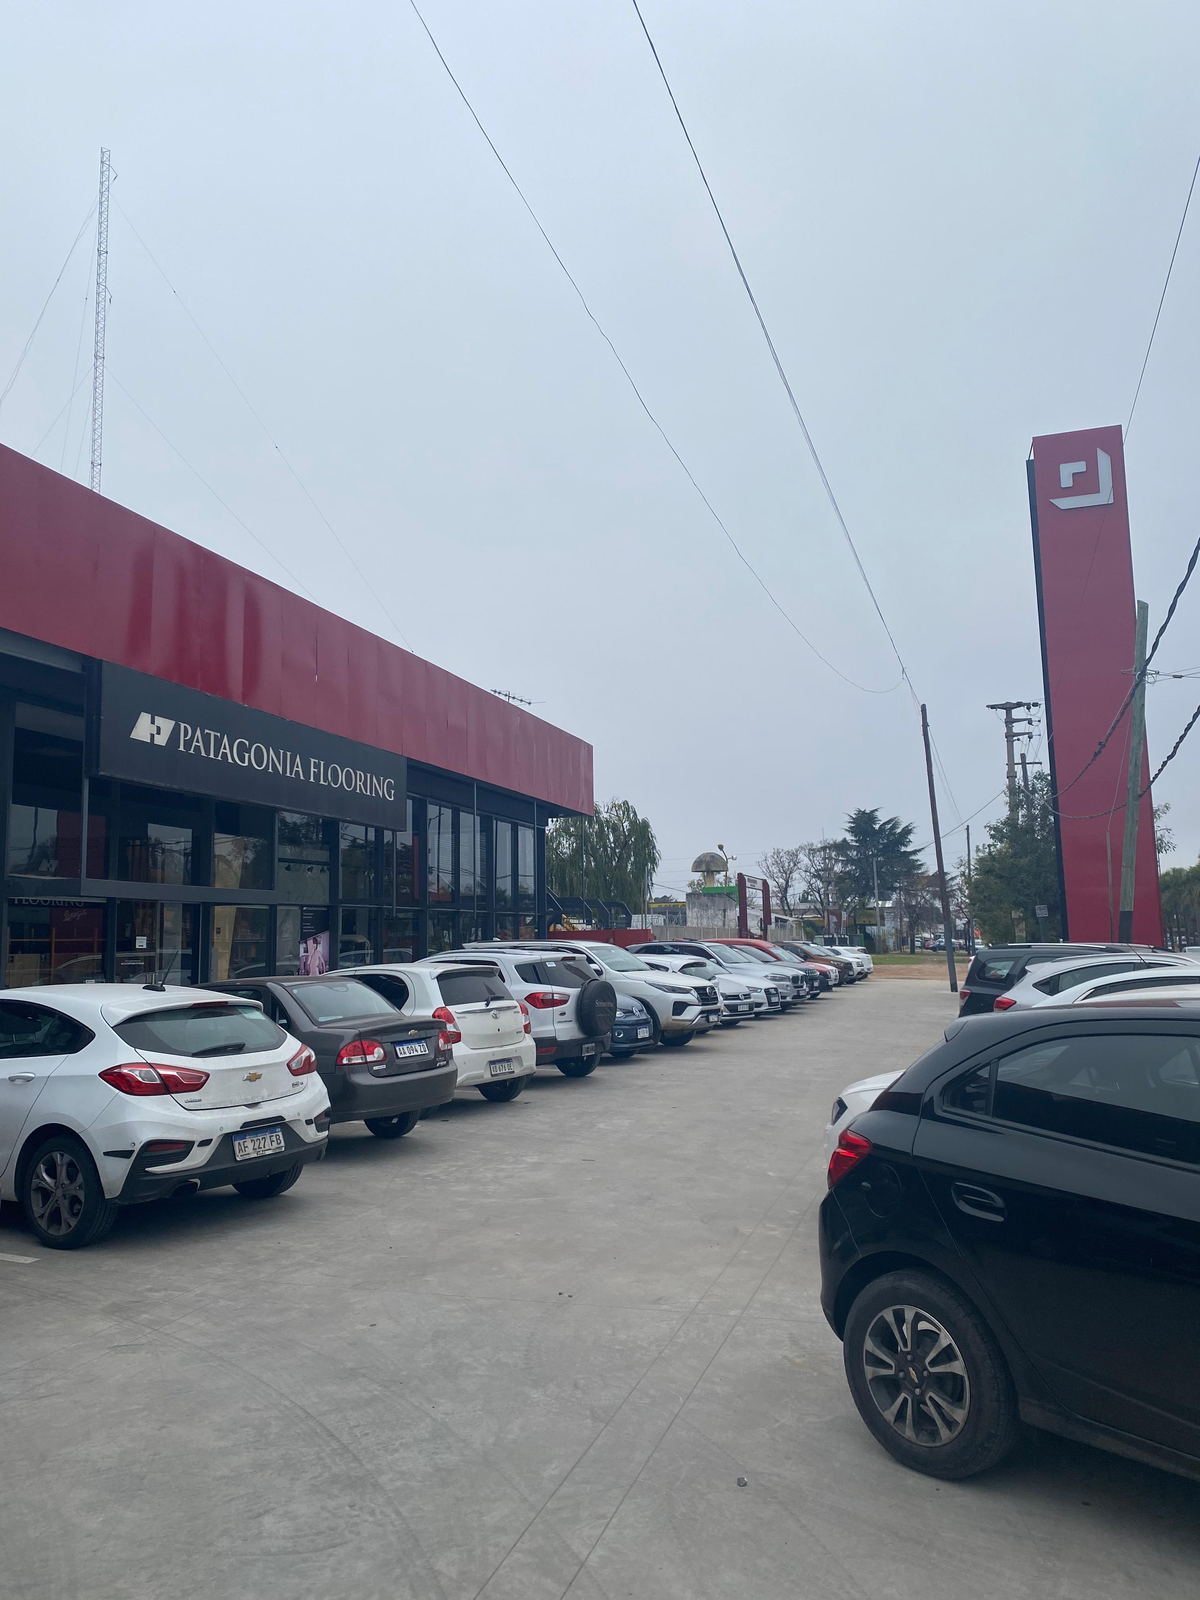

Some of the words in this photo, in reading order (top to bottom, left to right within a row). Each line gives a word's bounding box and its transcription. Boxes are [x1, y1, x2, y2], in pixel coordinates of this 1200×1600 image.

[178, 721, 305, 781] PATAGONIA
[309, 757, 395, 801] FLOORING
[238, 1141, 249, 1153] AF
[251, 1137, 266, 1150] 227
[269, 1134, 281, 1146] FB
